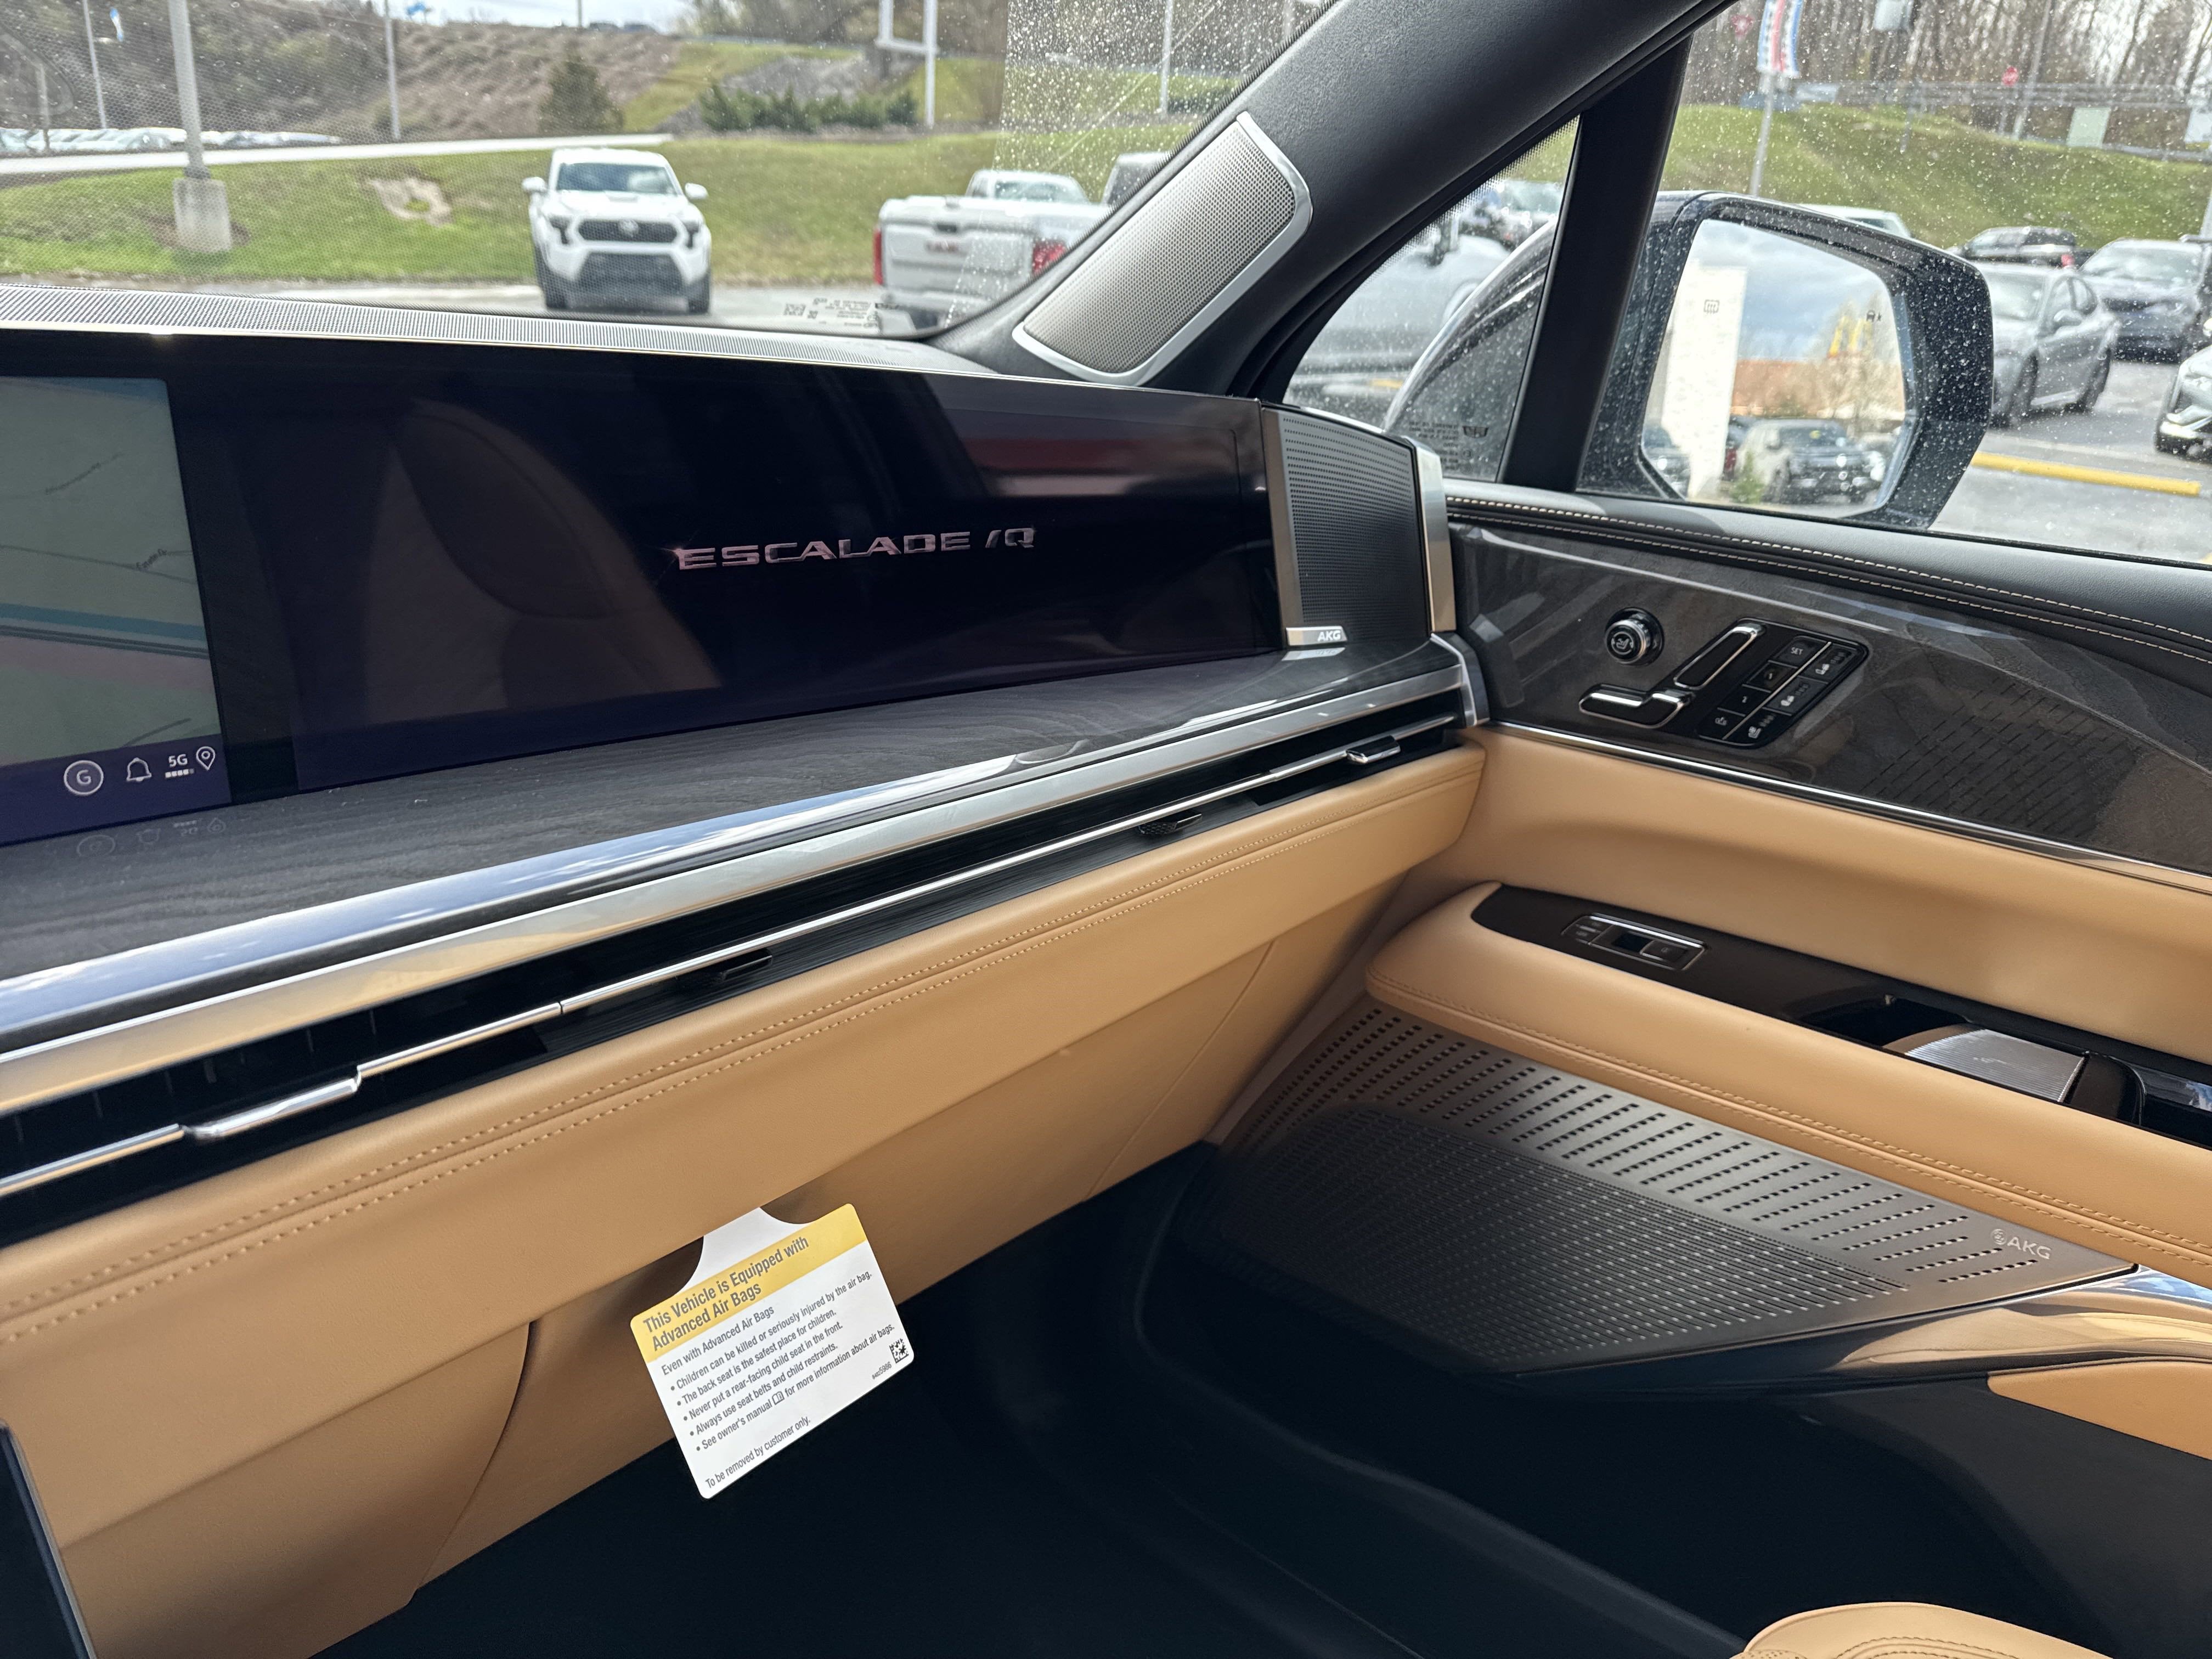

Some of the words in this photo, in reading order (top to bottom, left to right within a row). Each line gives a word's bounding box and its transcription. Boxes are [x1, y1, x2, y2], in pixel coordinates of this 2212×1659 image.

[678, 531, 970, 570] ESCALADE
[1318, 630, 1341, 641] AKG
[1791, 647, 1804, 656] SET
[76, 769, 92, 786] G
[168, 753, 188, 768] 5G
[2007, 1236, 2051, 1260] AKG
[642, 1311, 672, 1333] This
[669, 1287, 716, 1318] Vehicle
[715, 1280, 730, 1294] is
[729, 1248, 784, 1287] Equipped
[782, 1235, 809, 1258] with
[652, 1307, 712, 1352] Advanced
[712, 1299, 729, 1319] Air
[729, 1283, 761, 1307] Bags
[661, 1358, 683, 1376] Even
[681, 1346, 702, 1363] with
[702, 1322, 741, 1353] Advanced
[741, 1317, 753, 1331] Air
[752, 1306, 775, 1323] Bags
[675, 1365, 709, 1389] Children
[709, 1356, 725, 1370] can
[723, 1350, 736, 1361] be
[735, 1334, 758, 1355] killed
[758, 1330, 767, 1342] or
[767, 1311, 800, 1336] seriously
[799, 1295, 826, 1317] injured
[824, 1291, 835, 1302] by
[834, 1284, 847, 1296] the
[847, 1278, 856, 1289] air
[855, 1270, 872, 1283] bag.
[681, 1390, 698, 1404] The
[696, 1378, 718, 1396] back
[716, 1368, 734, 1384] seat
[732, 1364, 742, 1374] is
[740, 1357, 754, 1370] the
[754, 1342, 778, 1362] safest
[776, 1331, 797, 1350] place
[795, 1324, 807, 1336] for
[807, 1308, 837, 1330] children.
[688, 1400, 711, 1420] Never
[711, 1391, 726, 1408] put
[724, 1389, 732, 1398] a
[730, 1364, 772, 1394] rear-facing
[771, 1352, 789, 1369] child
[788, 1342, 806, 1359] seat
[803, 1339, 813, 1349] in
[811, 1332, 825, 1345] the
[823, 1321, 843, 1337] front.
[695, 1413, 723, 1435] Always
[721, 1404, 737, 1418] use
[736, 1392, 754, 1409] seat
[752, 1382, 772, 1399] belts
[771, 1371, 787, 1387] and
[786, 1361, 804, 1378] child
[803, 1342, 838, 1368] restraints.
[701, 1435, 717, 1449] See
[716, 1417, 746, 1440] owner's
[745, 1398, 773, 1422] manual
[784, 1385, 795, 1397] for
[795, 1374, 814, 1391] more
[812, 1351, 851, 1379] information
[850, 1338, 870, 1356] about
[868, 1333, 877, 1344] air
[876, 1323, 895, 1338] bags.
[704, 1477, 716, 1488] To
[714, 1471, 725, 1483] be
[725, 1449, 755, 1476] removed
[753, 1445, 764, 1457] by
[763, 1425, 794, 1451] customer
[794, 1415, 811, 1431] only.
